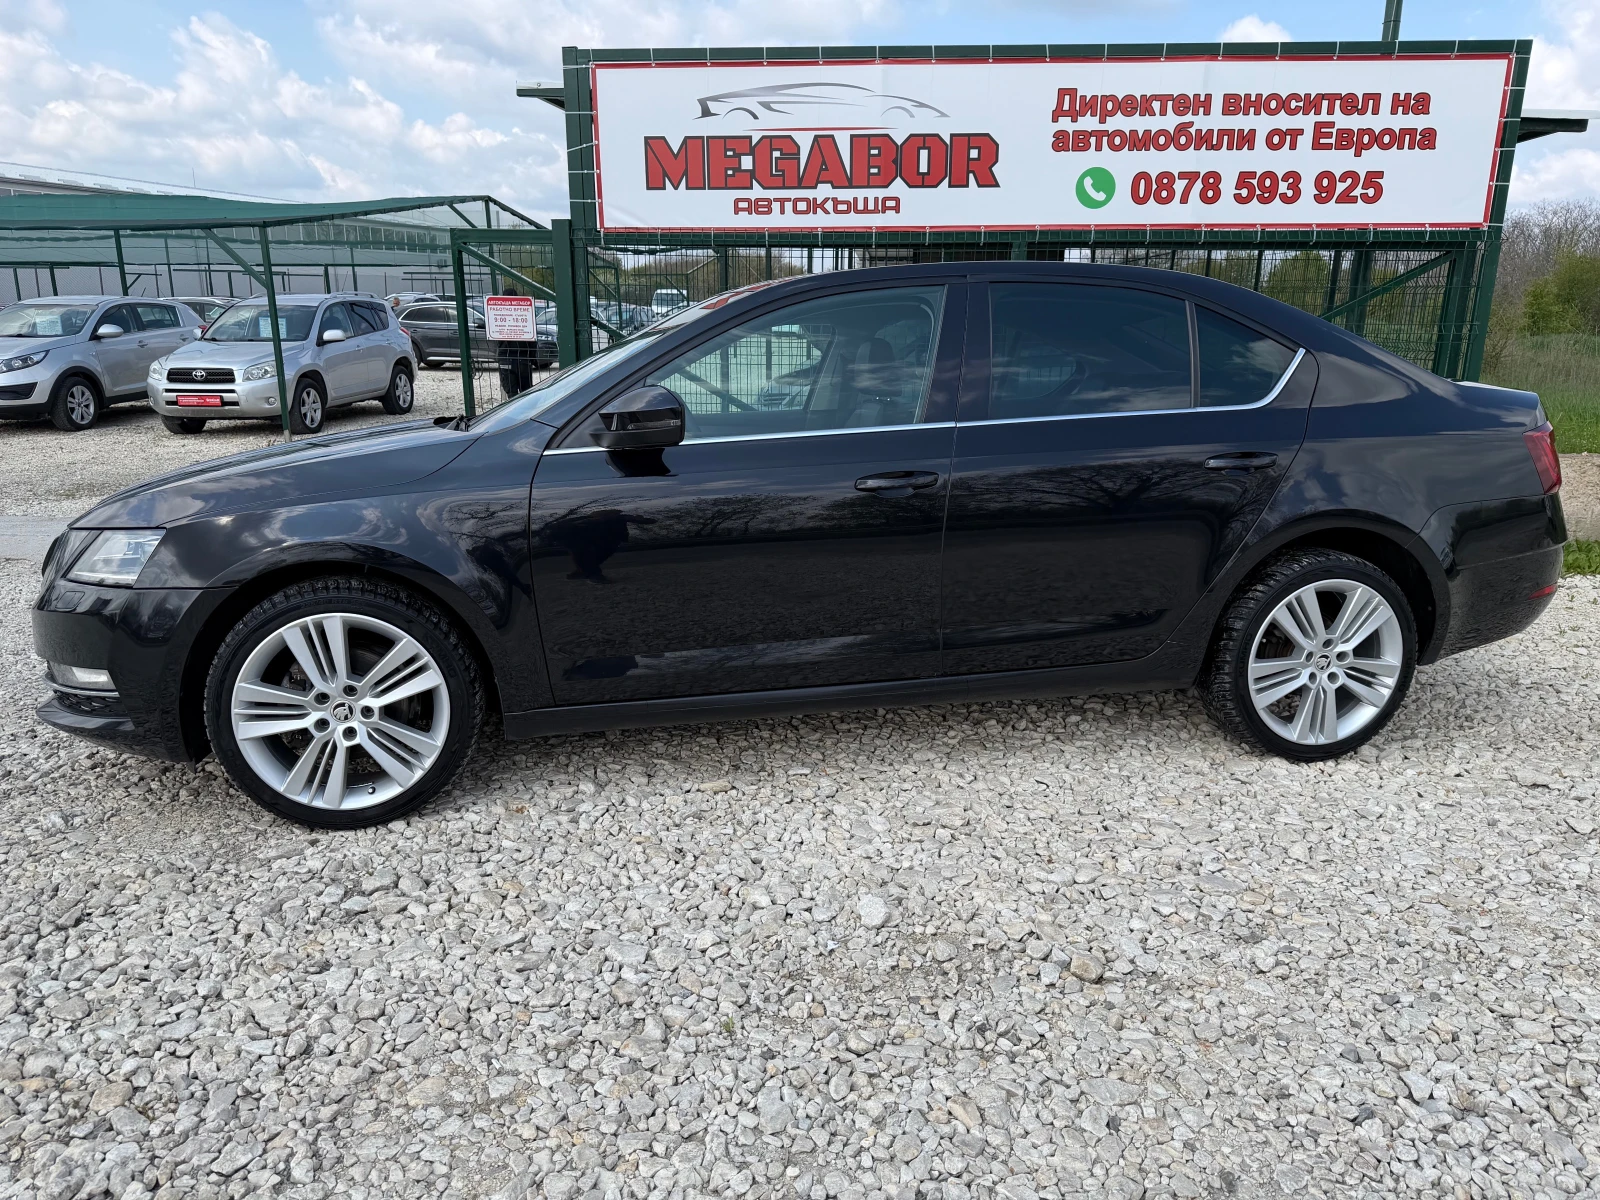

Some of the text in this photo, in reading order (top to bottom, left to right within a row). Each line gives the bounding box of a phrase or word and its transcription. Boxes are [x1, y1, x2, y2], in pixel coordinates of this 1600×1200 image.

[1052, 88, 1431, 123] Директен вносител на
[1052, 121, 1437, 157] автомобили от Европа
[643, 133, 1001, 191] MEGABOR
[733, 196, 901, 216] АВТОКЪЩА
[1131, 170, 1384, 206] 0878 593 925
